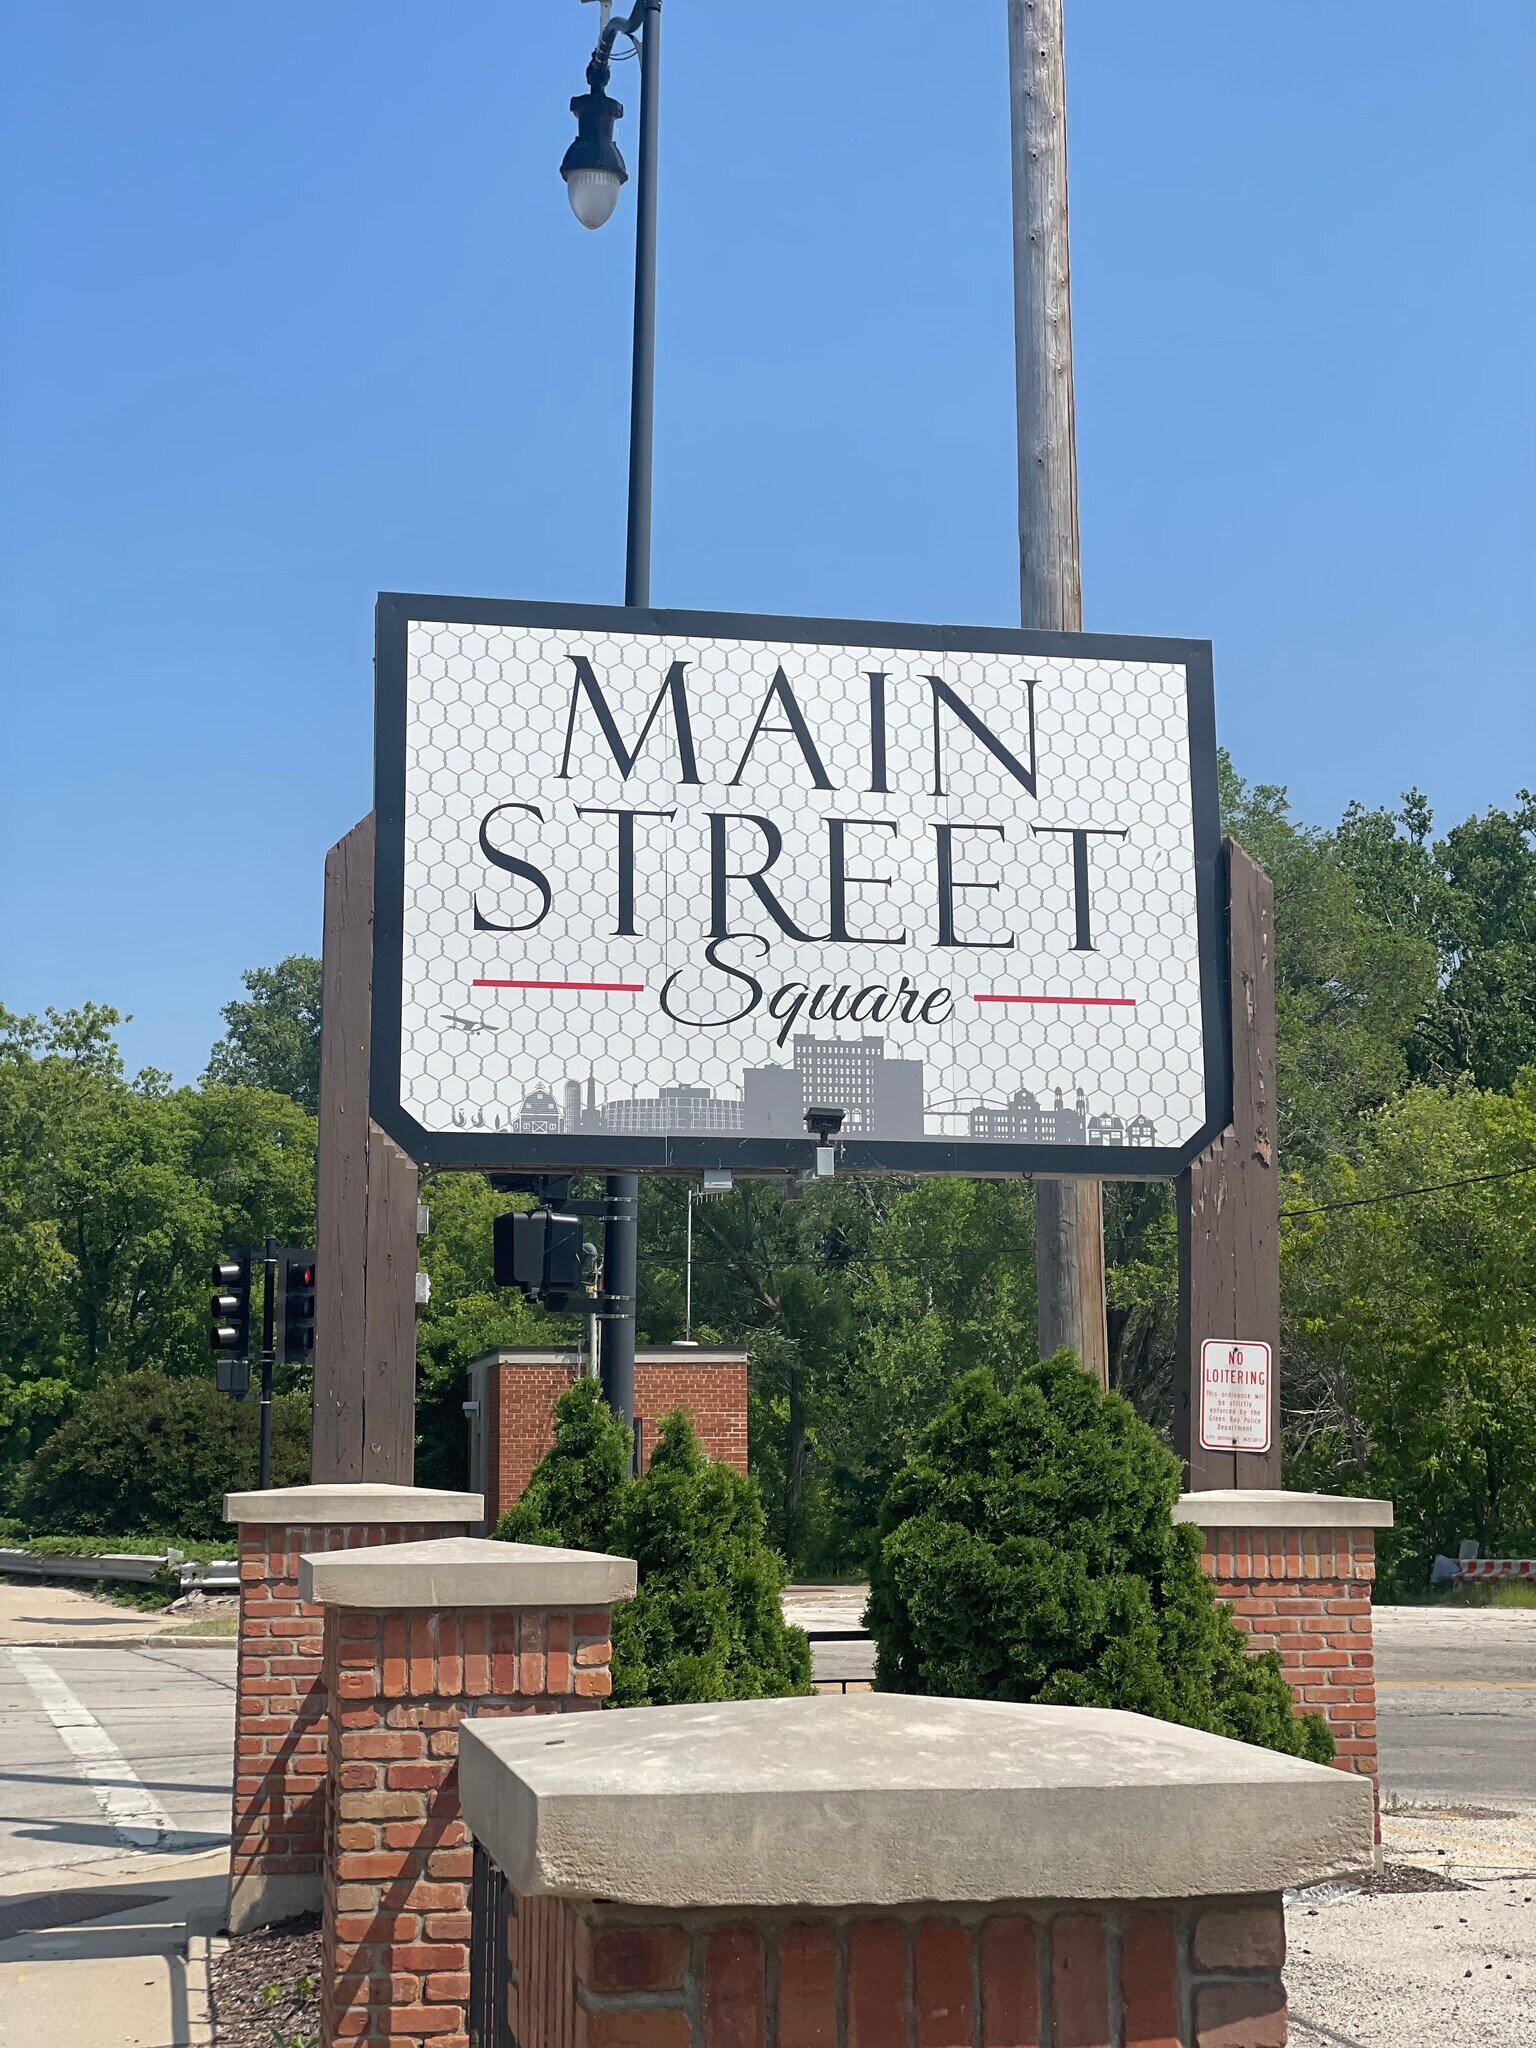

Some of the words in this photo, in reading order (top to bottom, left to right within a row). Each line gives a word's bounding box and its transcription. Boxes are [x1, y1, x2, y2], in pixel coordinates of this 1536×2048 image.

[554, 653, 1042, 799] MAIN
[472, 802, 1129, 953] STREET
[659, 933, 954, 1049] Square
[1229, 1351, 1244, 1366] NO
[1206, 1368, 1265, 1386] LOITERING
[1218, 1424, 1252, 1432] Department
[1244, 1416, 1261, 1424] Police
